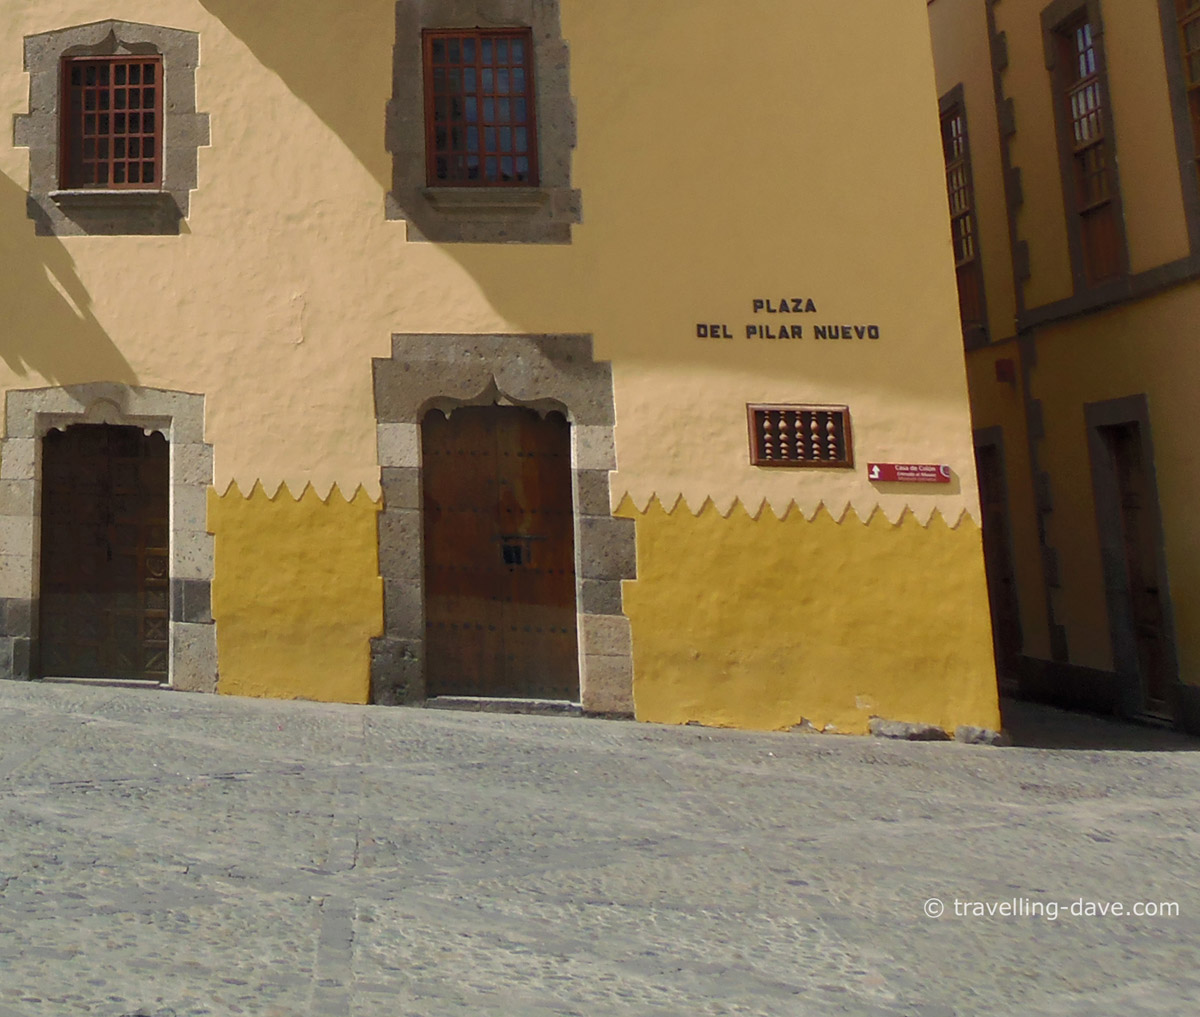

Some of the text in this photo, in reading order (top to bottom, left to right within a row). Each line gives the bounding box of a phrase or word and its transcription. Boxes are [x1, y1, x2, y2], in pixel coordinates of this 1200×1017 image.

[753, 298, 817, 313] PLAZA
[696, 324, 880, 340] DEL PILAR NUEVO
